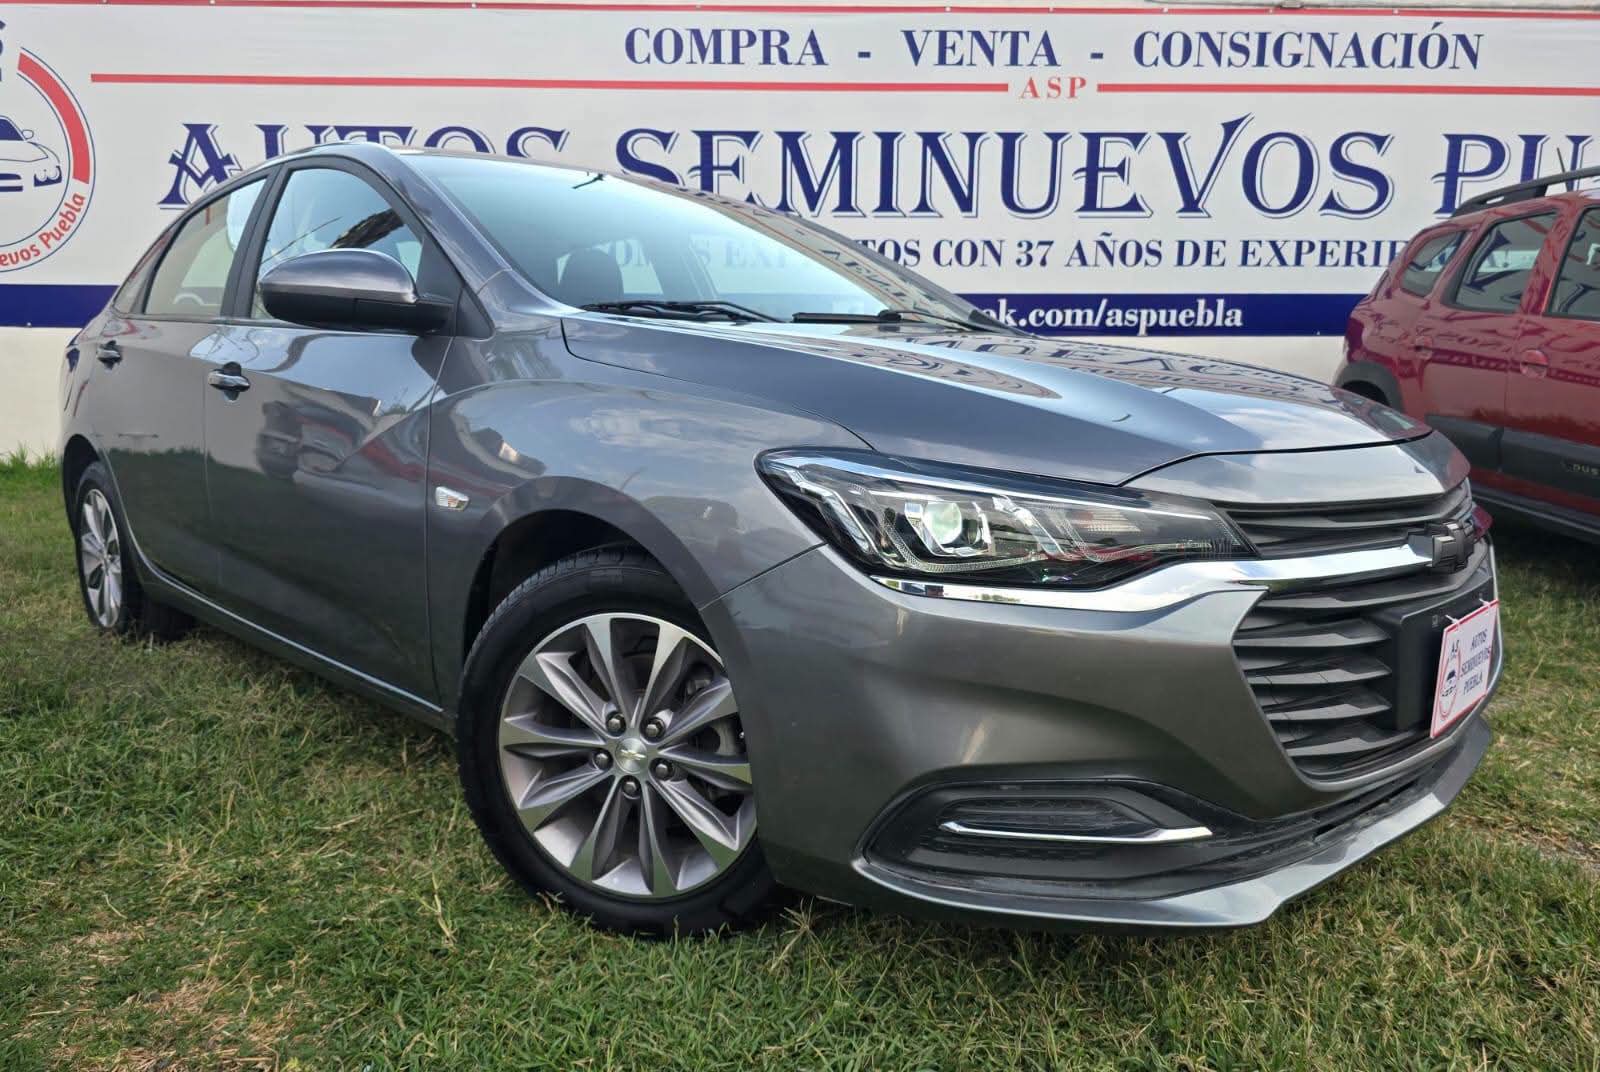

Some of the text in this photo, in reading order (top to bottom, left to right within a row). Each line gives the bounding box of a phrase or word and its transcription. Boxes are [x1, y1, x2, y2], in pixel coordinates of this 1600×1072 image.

[624, 27, 828, 67] COMPRA
[901, 29, 1061, 67] VENTA
[1133, 22, 1485, 70] CONSIGNACIÓN
[1020, 76, 1087, 99] ASP
[614, 113, 1396, 219] SEMINUEVOS
[38, 192, 86, 249] Puebla
[932, 239, 1005, 267] CON
[1015, 239, 1055, 268] 37
[1064, 232, 1163, 268] AÑOS
[1174, 239, 1226, 267] DE
